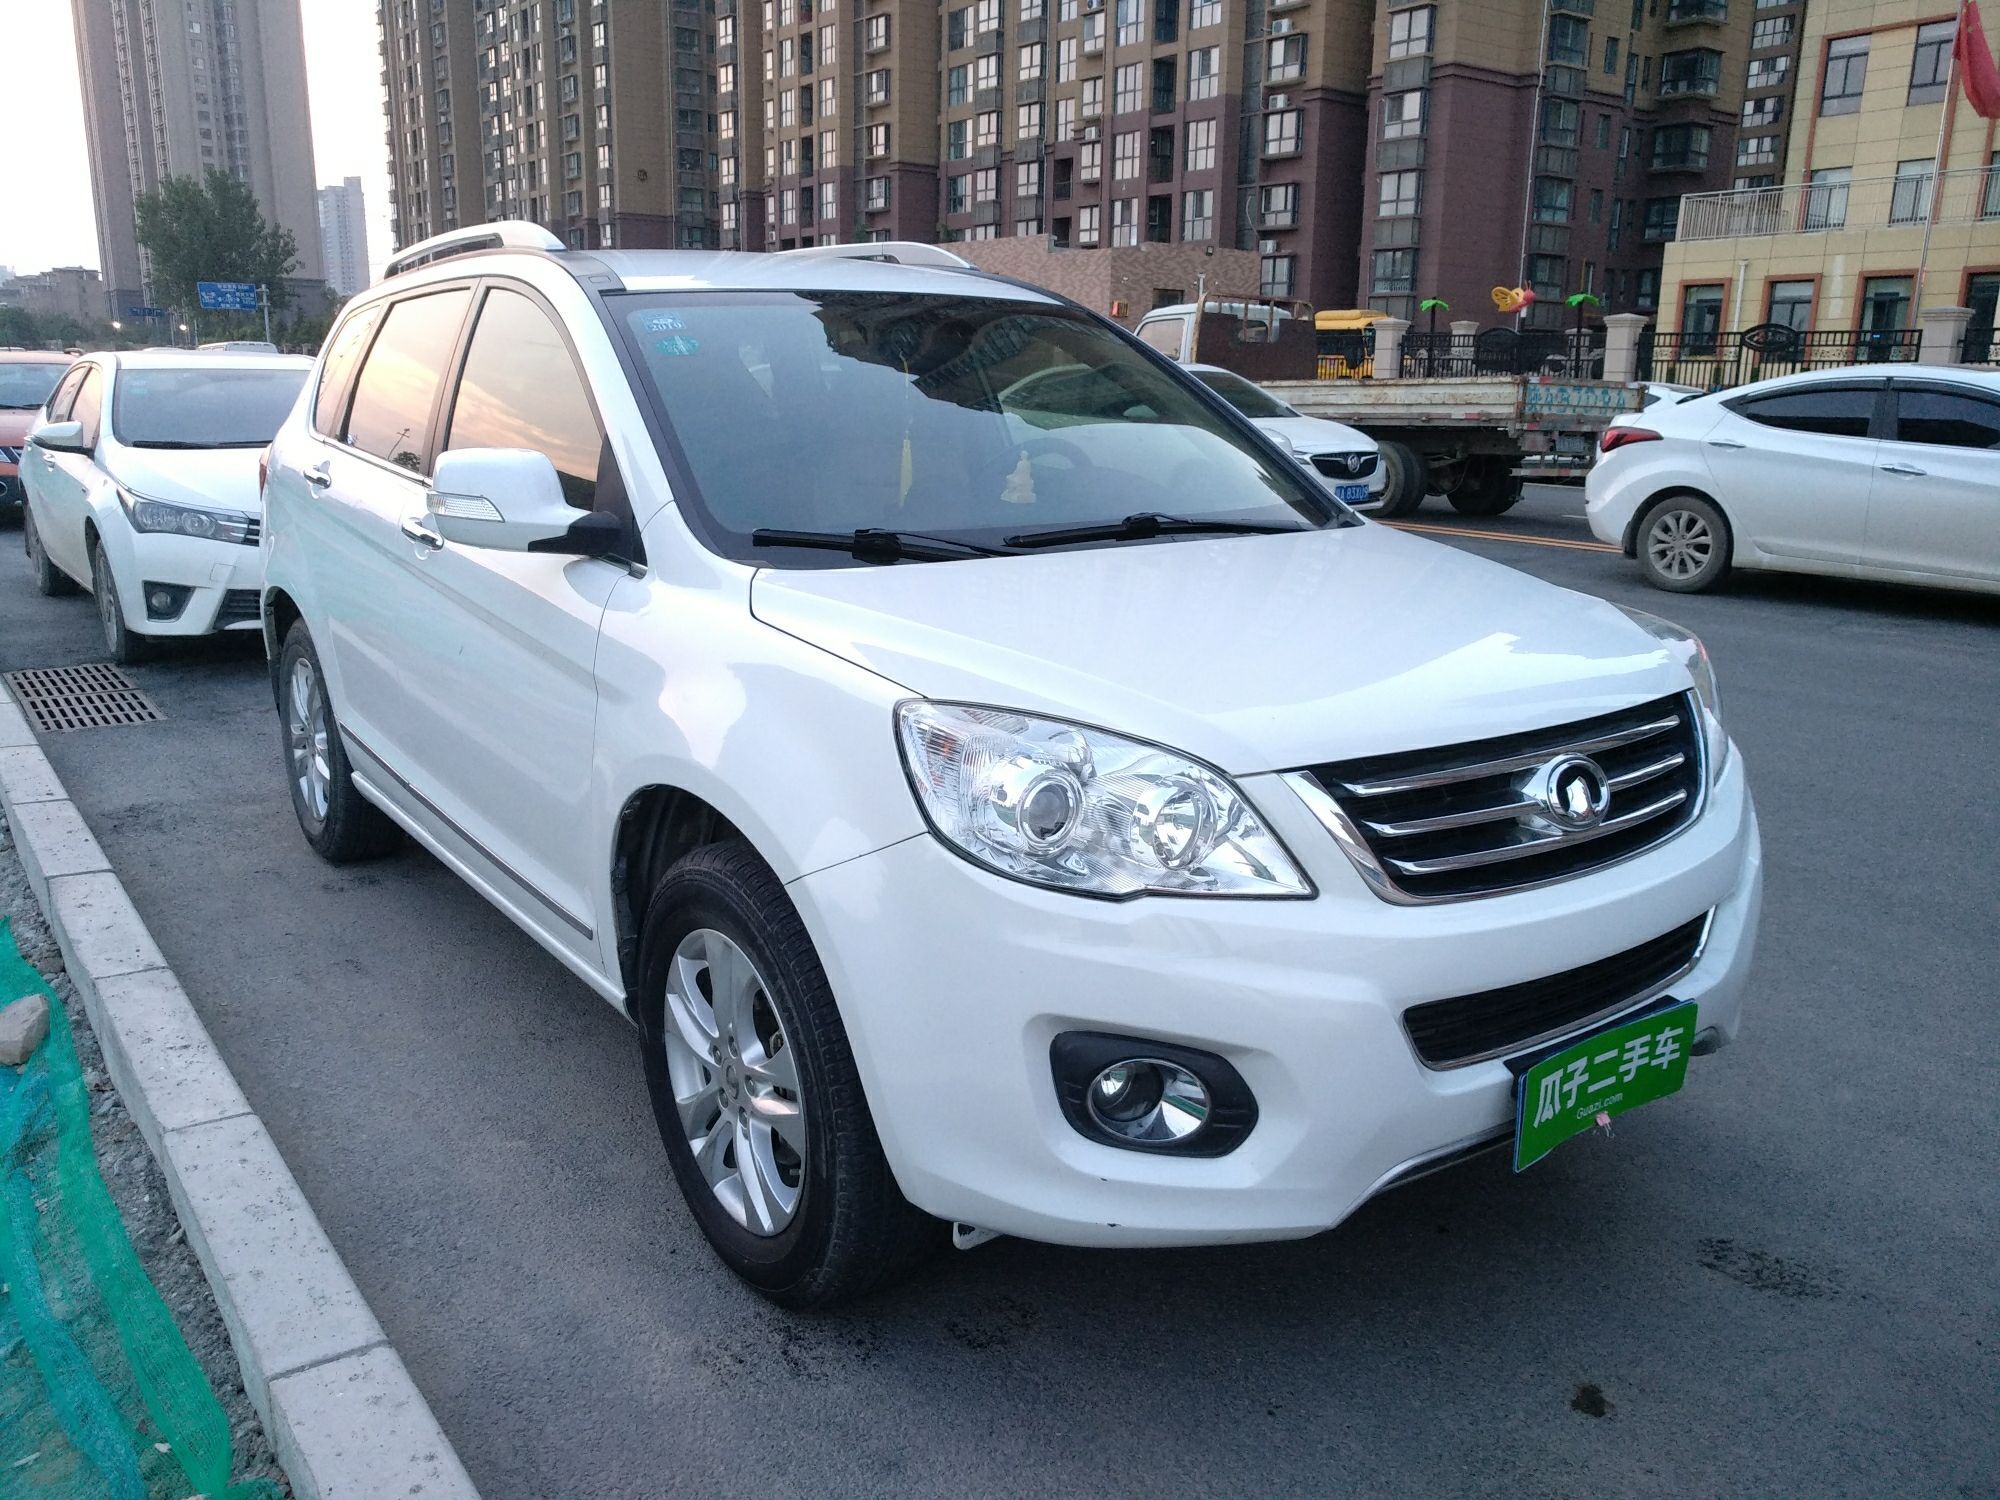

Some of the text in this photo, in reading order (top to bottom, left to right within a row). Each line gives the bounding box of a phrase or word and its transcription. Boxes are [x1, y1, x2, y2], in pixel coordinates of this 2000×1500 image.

[1533, 1027, 1684, 1128] 瓜子二手车
